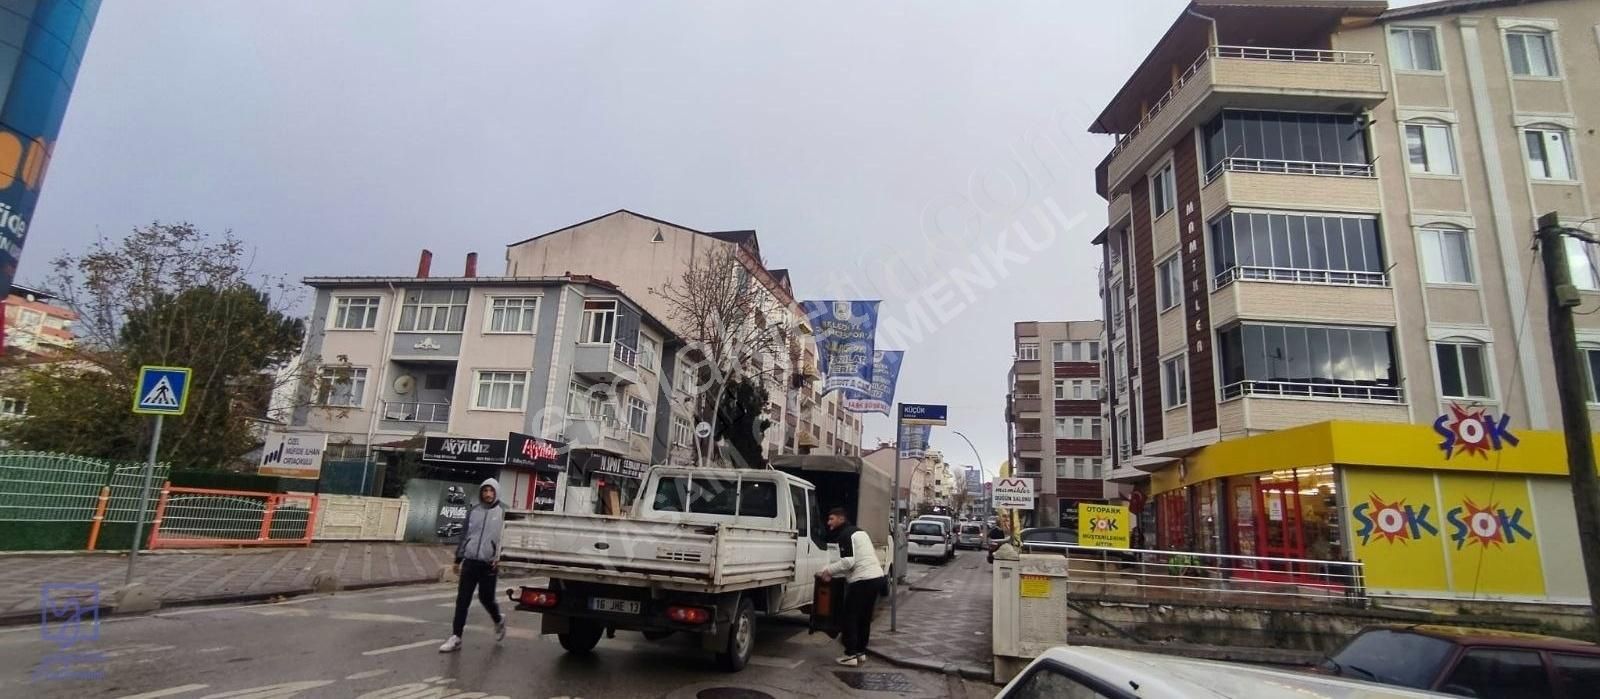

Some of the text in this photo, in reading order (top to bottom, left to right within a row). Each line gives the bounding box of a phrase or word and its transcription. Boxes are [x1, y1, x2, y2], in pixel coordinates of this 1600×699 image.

[904, 405, 926, 414] KÜÇÜK
[1433, 411, 1520, 460] ŞOK
[1086, 506, 1122, 515] OTOPARK
[1089, 517, 1119, 533] ŞOK
[1352, 501, 1440, 547] ŞOK
[1446, 505, 1533, 551] ŞOK
[595, 599, 606, 609] 16
